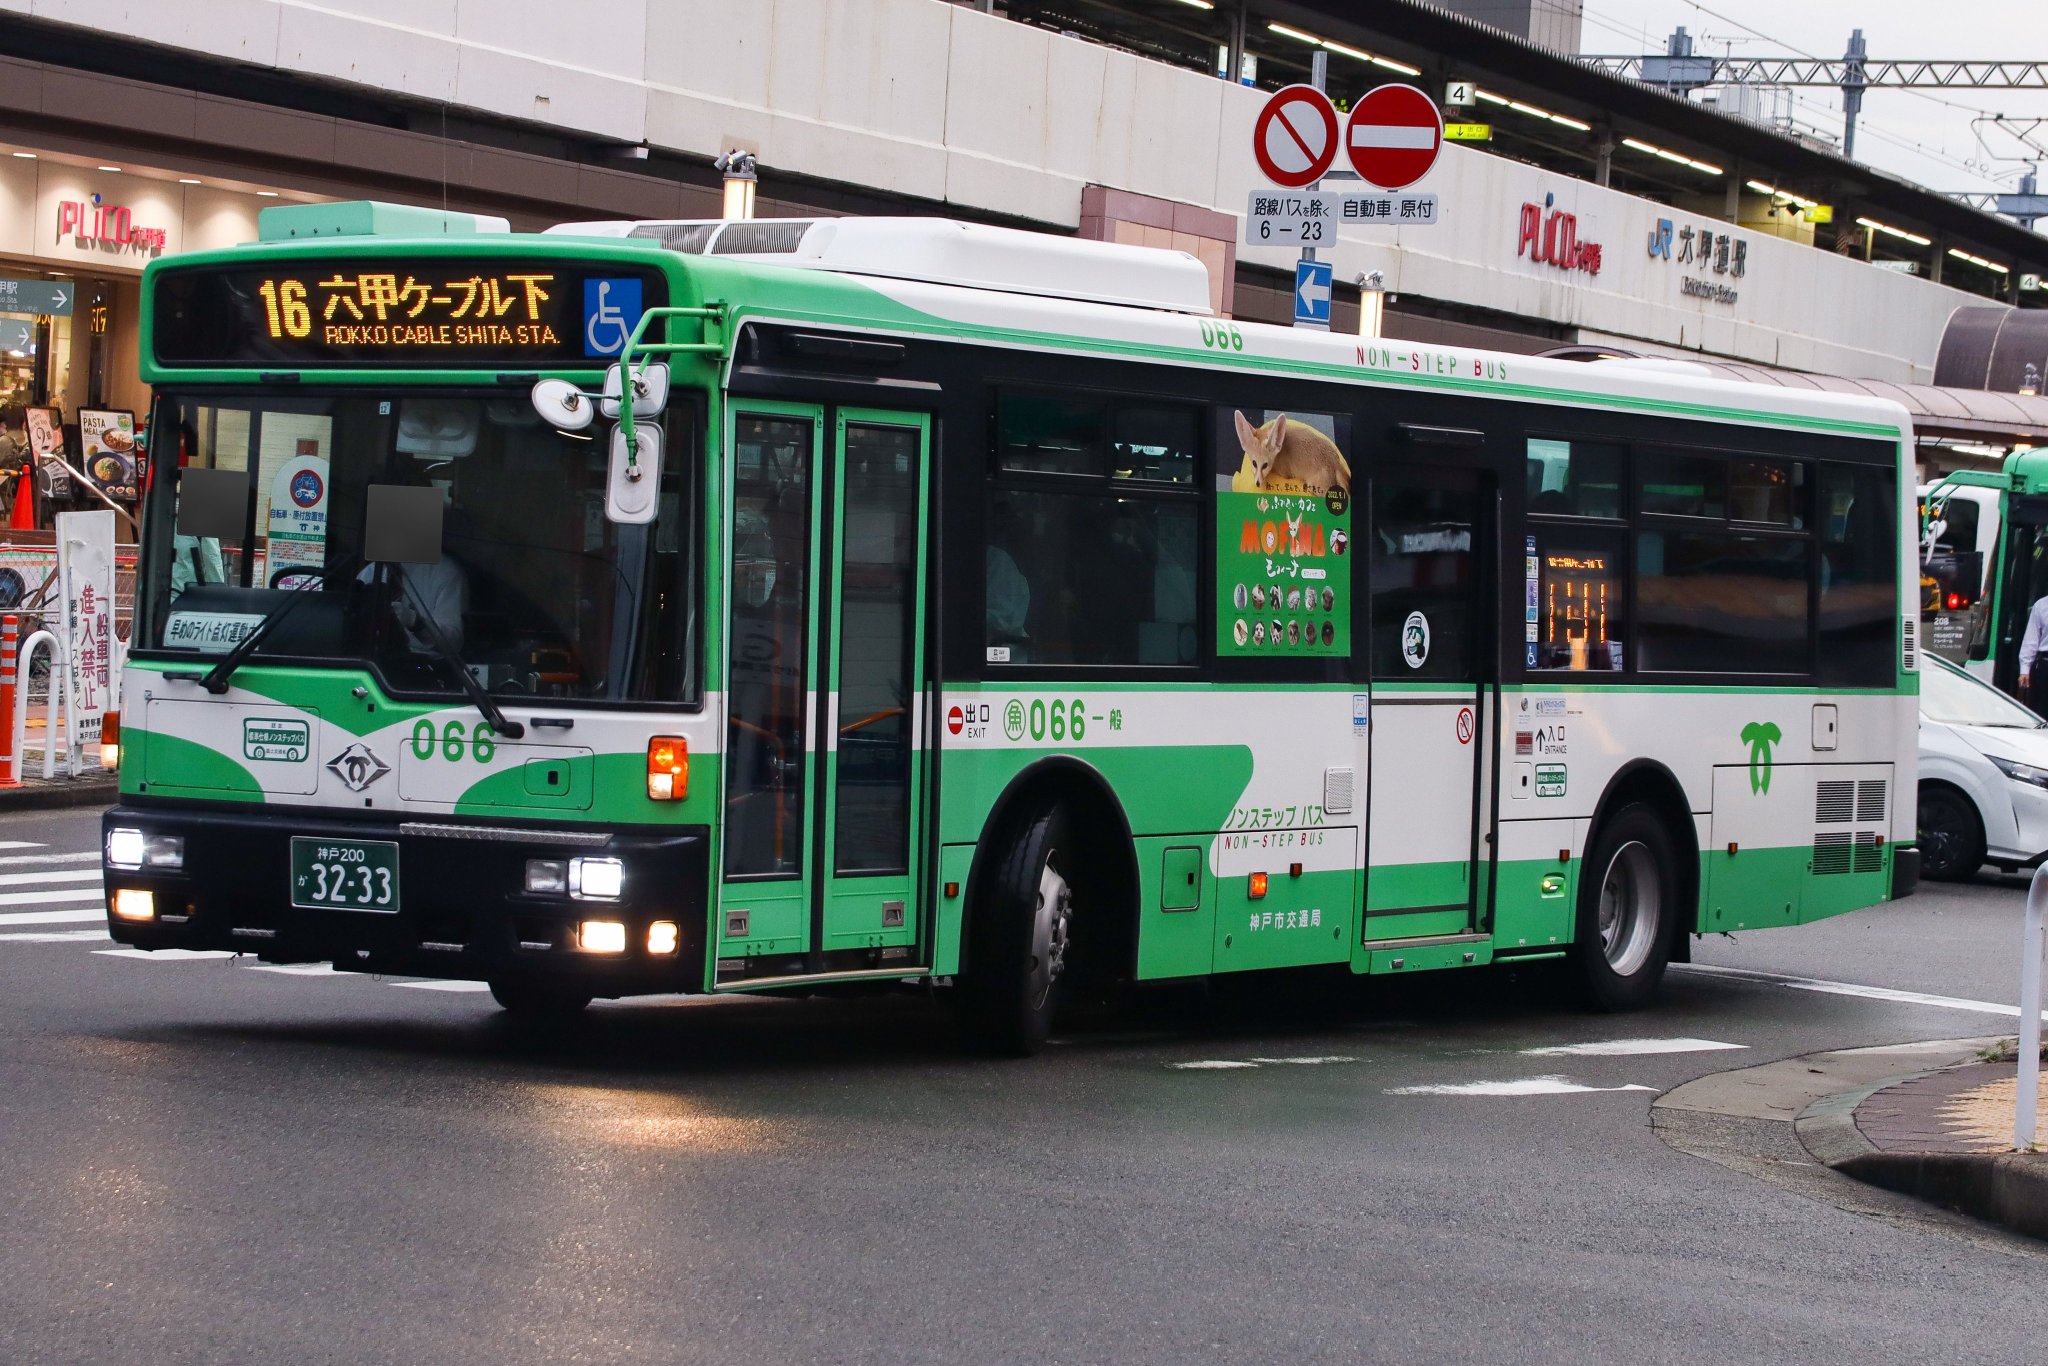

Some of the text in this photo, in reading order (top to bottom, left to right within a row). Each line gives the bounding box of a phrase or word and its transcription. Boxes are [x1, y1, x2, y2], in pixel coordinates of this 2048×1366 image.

[1453, 86, 1465, 101] 4
[1254, 197, 1330, 217] 路線バスを除く
[1647, 218, 1747, 278] JR 六甲道駅
[2024, 277, 2032, 288] 4
[259, 273, 555, 338] 16 六甲ケーブル下
[325, 325, 561, 345] ROKKO CABLE SHITA STA.
[1199, 319, 1244, 351] 066
[1474, 358, 1508, 381] BUS
[83, 417, 106, 428] PASTA
[80, 584, 98, 711] 進入禁止
[96, 596, 109, 688] 一般車両
[965, 703, 990, 724] 出口
[1030, 698, 1086, 742] 066
[412, 718, 496, 764] 066
[967, 727, 987, 739] EXIT
[1547, 725, 1565, 742] 入口
[1544, 744, 1567, 755] ENTRANCE
[1225, 804, 1325, 829] ノンステップ バス
[1300, 831, 1324, 846] BUS
[311, 862, 392, 905] 32-33
[1249, 908, 1321, 932] 神戸市交通局
